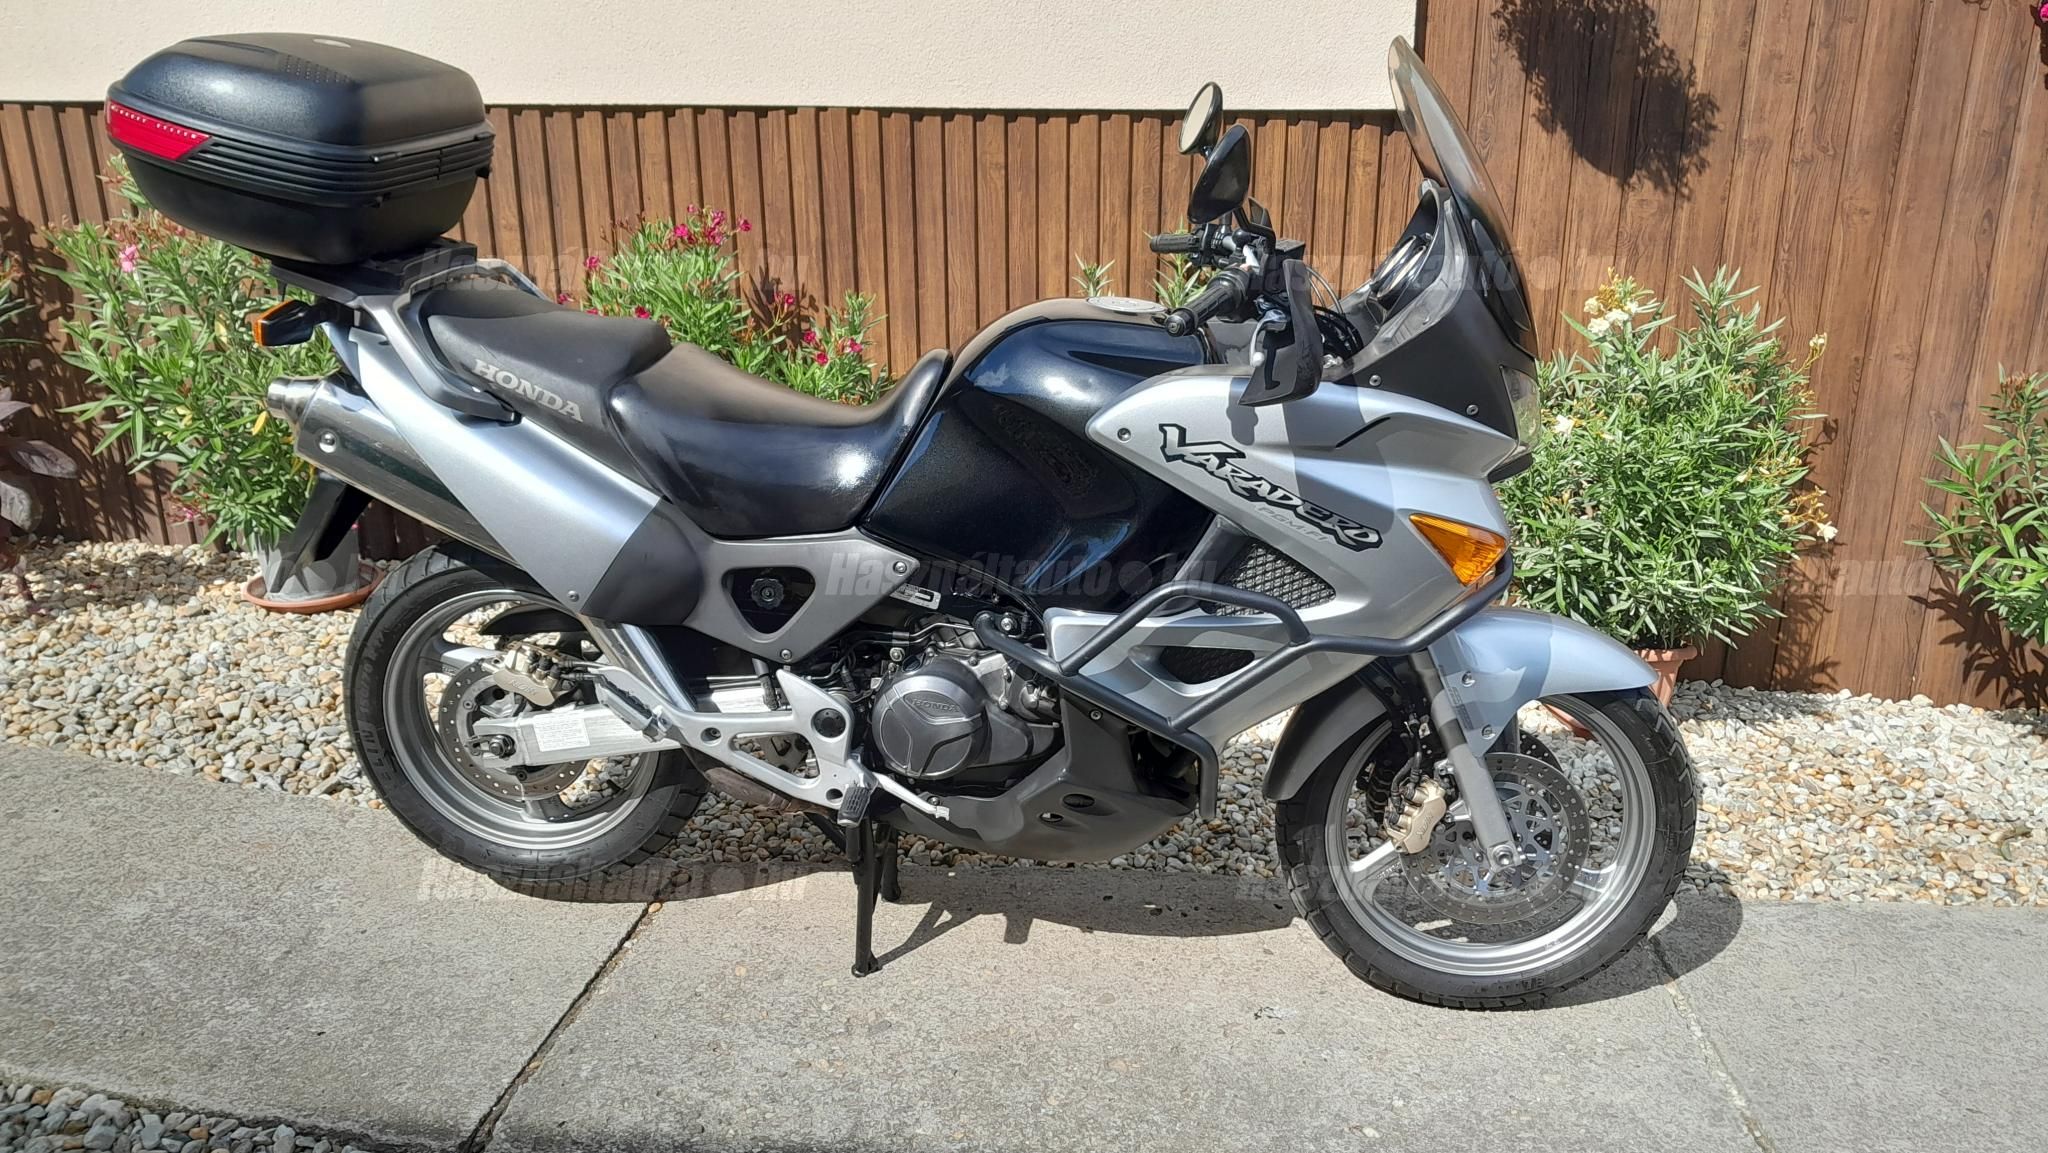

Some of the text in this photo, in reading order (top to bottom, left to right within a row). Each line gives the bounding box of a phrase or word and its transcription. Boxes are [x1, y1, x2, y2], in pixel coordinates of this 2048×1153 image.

[472, 359, 584, 423] HONDA
[1159, 423, 1384, 552] VARADERO
[911, 698, 960, 713] HONDA
